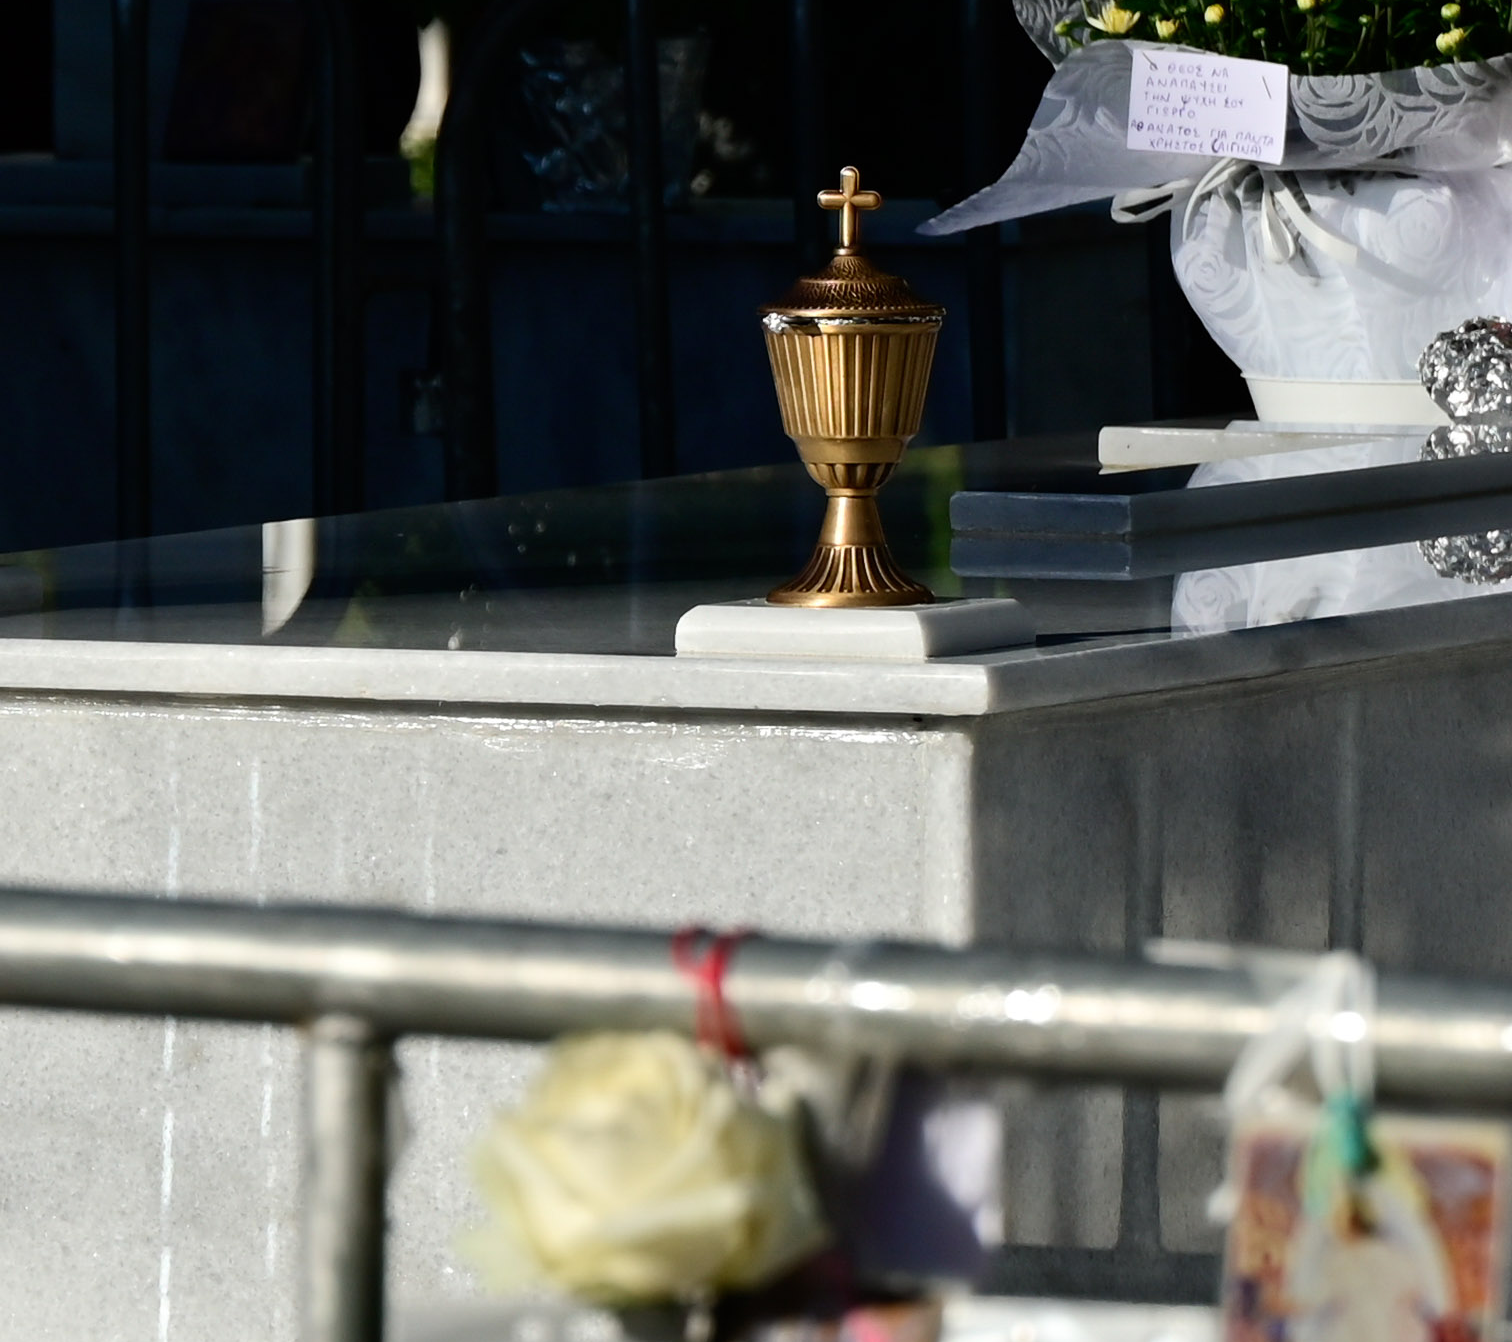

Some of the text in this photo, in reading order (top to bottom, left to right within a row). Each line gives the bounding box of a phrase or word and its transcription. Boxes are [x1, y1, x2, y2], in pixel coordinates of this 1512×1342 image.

[1211, 67, 1230, 78] ΝΑ
[1145, 76, 1227, 93] ΑΝΑΠΑΥΣΕΙ
[1144, 91, 1245, 109] ΤΗΝ ΨΥΧΗ ΣΟΥ
[1130, 119, 1274, 146] ΑΘΑΝΑΤΟΣ ΓΙΑ ΠΑΝΤΑ
[1148, 138, 1204, 153] ΧΡΗΣΤΟΣ
